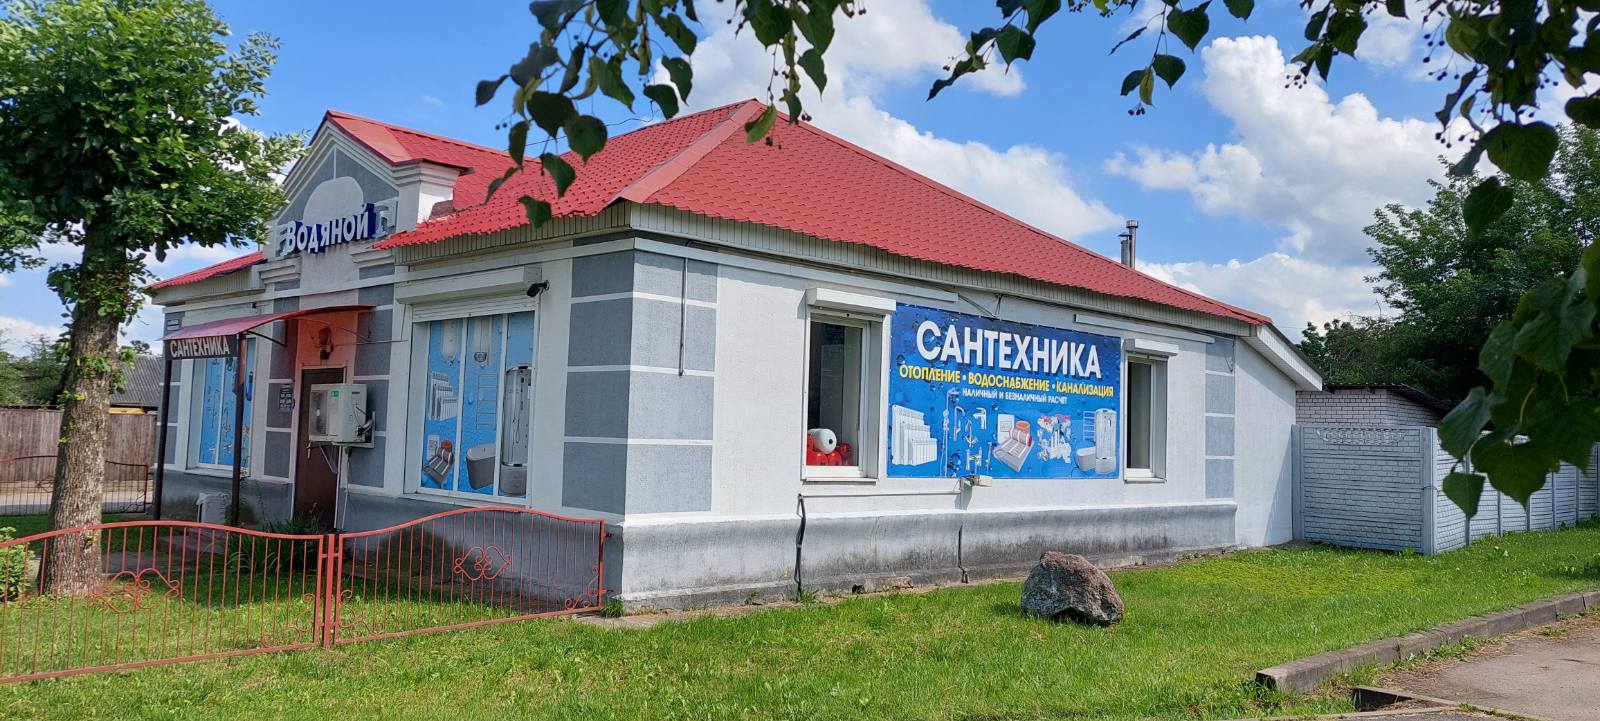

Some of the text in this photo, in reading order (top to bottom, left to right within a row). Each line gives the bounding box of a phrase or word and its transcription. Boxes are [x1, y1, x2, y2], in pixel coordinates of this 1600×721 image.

[282, 203, 371, 254] ВОДЯНОЙ
[170, 335, 231, 358] САНТЕХНИКА
[916, 320, 1102, 379] САНТЕХНИКА
[899, 364, 1114, 398] ОТОПЛЕНИЕ ВОДОСНАБЖЕНИЕ КАНАЛИЗАЦИЯ
[962, 387, 998, 399] НАЛИЧНЫЙ
[999, 391, 1004, 399] И
[1005, 391, 1047, 403] БЕЗНАЛИЧНЫЙ
